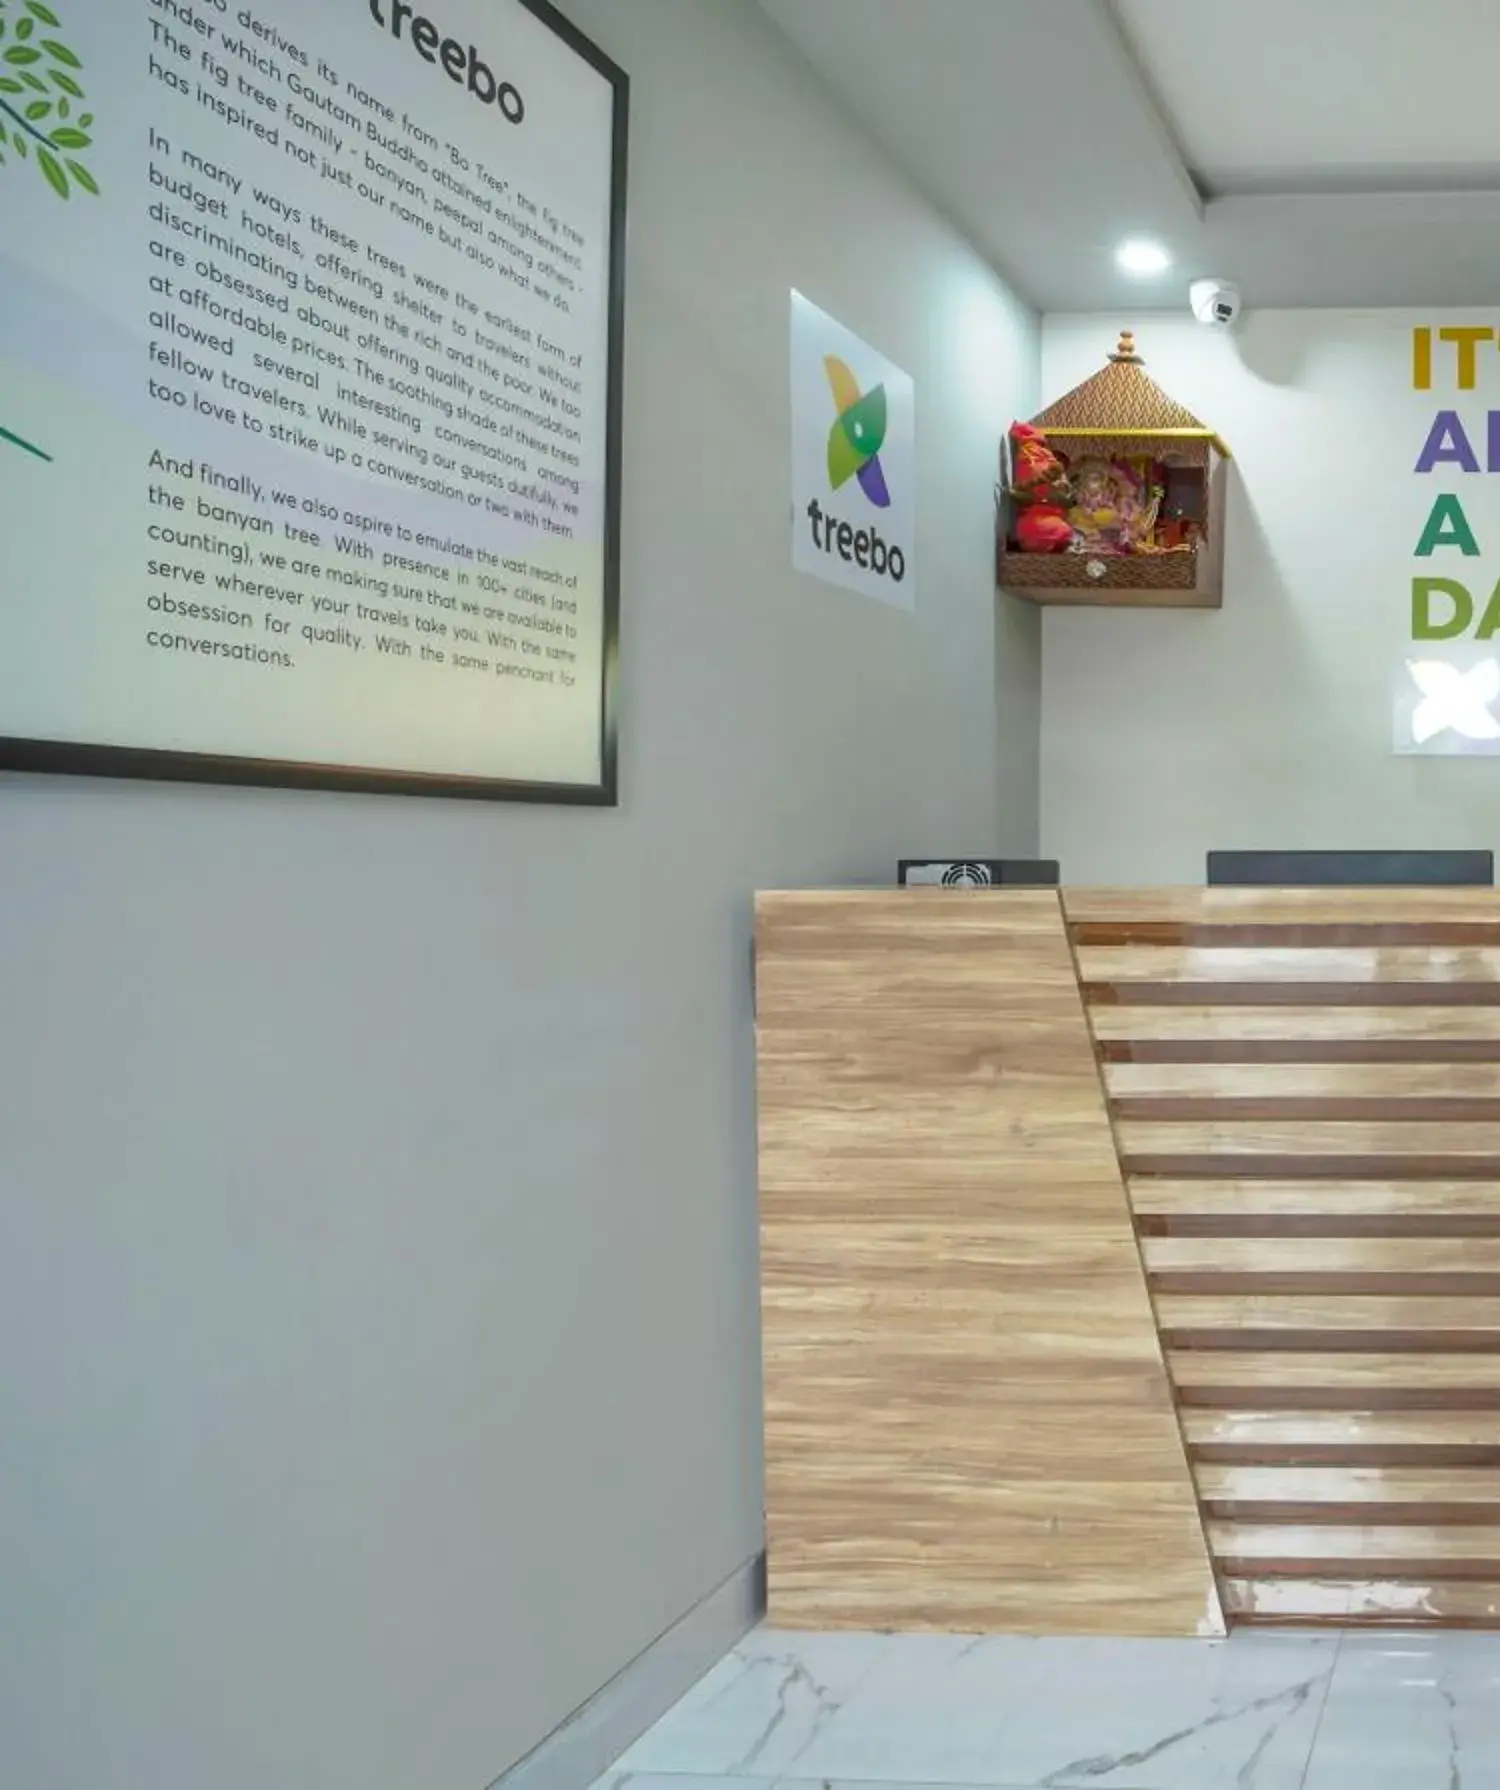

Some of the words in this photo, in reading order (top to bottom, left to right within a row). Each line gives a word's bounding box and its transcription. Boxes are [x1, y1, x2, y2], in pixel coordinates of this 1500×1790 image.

[148, 17, 190, 60] The
[201, 51, 228, 87] fig
[237, 74, 277, 112] tree
[285, 102, 342, 153] family
[433, 197, 482, 235] peepal
[221, 33, 281, 82] which
[286, 72, 361, 132] Gautam
[237, 11, 308, 66] derives
[317, 58, 338, 85] its
[346, 82, 394, 122] name
[402, 113, 437, 150] from
[149, 53, 189, 94] has
[197, 83, 278, 146] inspired
[284, 139, 316, 169] not
[320, 156, 352, 188] just
[356, 183, 384, 206] our
[389, 201, 434, 234] name
[438, 224, 461, 251] but
[465, 244, 494, 269] also
[497, 263, 529, 289] what
[148, 201, 298, 289] discriminating
[304, 273, 378, 324] between
[383, 313, 409, 338] the
[414, 330, 441, 352] rich
[445, 347, 473, 368] and
[477, 358, 500, 381] the
[560, 397, 581, 418] too
[149, 127, 169, 155] In
[182, 150, 241, 194] many
[252, 188, 300, 223] ways
[310, 214, 359, 252] these
[367, 244, 405, 278] trees
[413, 273, 448, 300] were
[455, 291, 478, 315] the
[536, 333, 565, 361] form
[569, 354, 582, 368] of
[149, 161, 227, 219] budget
[314, 253, 383, 299] offering
[392, 290, 443, 324] shelter
[451, 318, 466, 336] to
[148, 240, 184, 267] are
[195, 261, 288, 312] obsessed
[296, 306, 349, 341] about
[357, 333, 419, 375] offering
[424, 364, 474, 398] quality
[149, 275, 172, 296] at
[178, 288, 286, 344] affordable
[353, 357, 384, 385] The
[387, 377, 453, 418] soothing
[456, 404, 497, 433] shade
[499, 423, 513, 438] of
[148, 311, 233, 356] allowed
[253, 353, 318, 390] several
[336, 382, 421, 433] interesting
[434, 425, 526, 472] conversations
[536, 466, 579, 495] among
[149, 341, 214, 382] fellow
[316, 405, 366, 438] While
[372, 431, 428, 465] serving
[432, 452, 456, 470] our
[562, 501, 578, 515] we
[149, 377, 186, 407] too
[193, 391, 236, 424] love
[242, 410, 262, 432] to
[269, 423, 318, 451] strike
[324, 444, 346, 463] up
[351, 452, 362, 467] a
[367, 458, 463, 500] conversation
[467, 492, 482, 506] or
[146, 524, 253, 566] counting),
[259, 551, 286, 569] we
[291, 559, 320, 578] are
[325, 567, 388, 597] making
[392, 583, 423, 602] sure
[426, 589, 457, 610] that
[460, 601, 480, 615] we
[482, 606, 504, 621] are
[565, 623, 576, 638] to
[148, 449, 193, 478] And
[200, 463, 264, 502] finally,
[271, 490, 296, 508] we
[301, 498, 338, 520] also
[343, 511, 392, 536] aspire
[396, 523, 412, 541] to
[415, 532, 473, 559] emulate
[476, 547, 498, 567] the
[501, 559, 527, 575] vast
[564, 575, 577, 588] of
[148, 484, 184, 510] the
[197, 495, 273, 535] banyan
[334, 535, 373, 559] With
[382, 552, 449, 581] presence
[457, 571, 469, 584] in
[807, 499, 905, 582] treebo
[1414, 493, 1481, 556] A
[146, 631, 294, 667] conversations.
[147, 559, 205, 584] serve
[215, 572, 304, 605] wherever
[310, 595, 350, 615] your
[356, 602, 409, 627] travels
[415, 614, 446, 635] take
[147, 591, 252, 627] obsession
[264, 612, 290, 634] for
[301, 624, 364, 651] quality.
[375, 634, 411, 655] With
[420, 643, 444, 662] the
[451, 653, 488, 671] same
